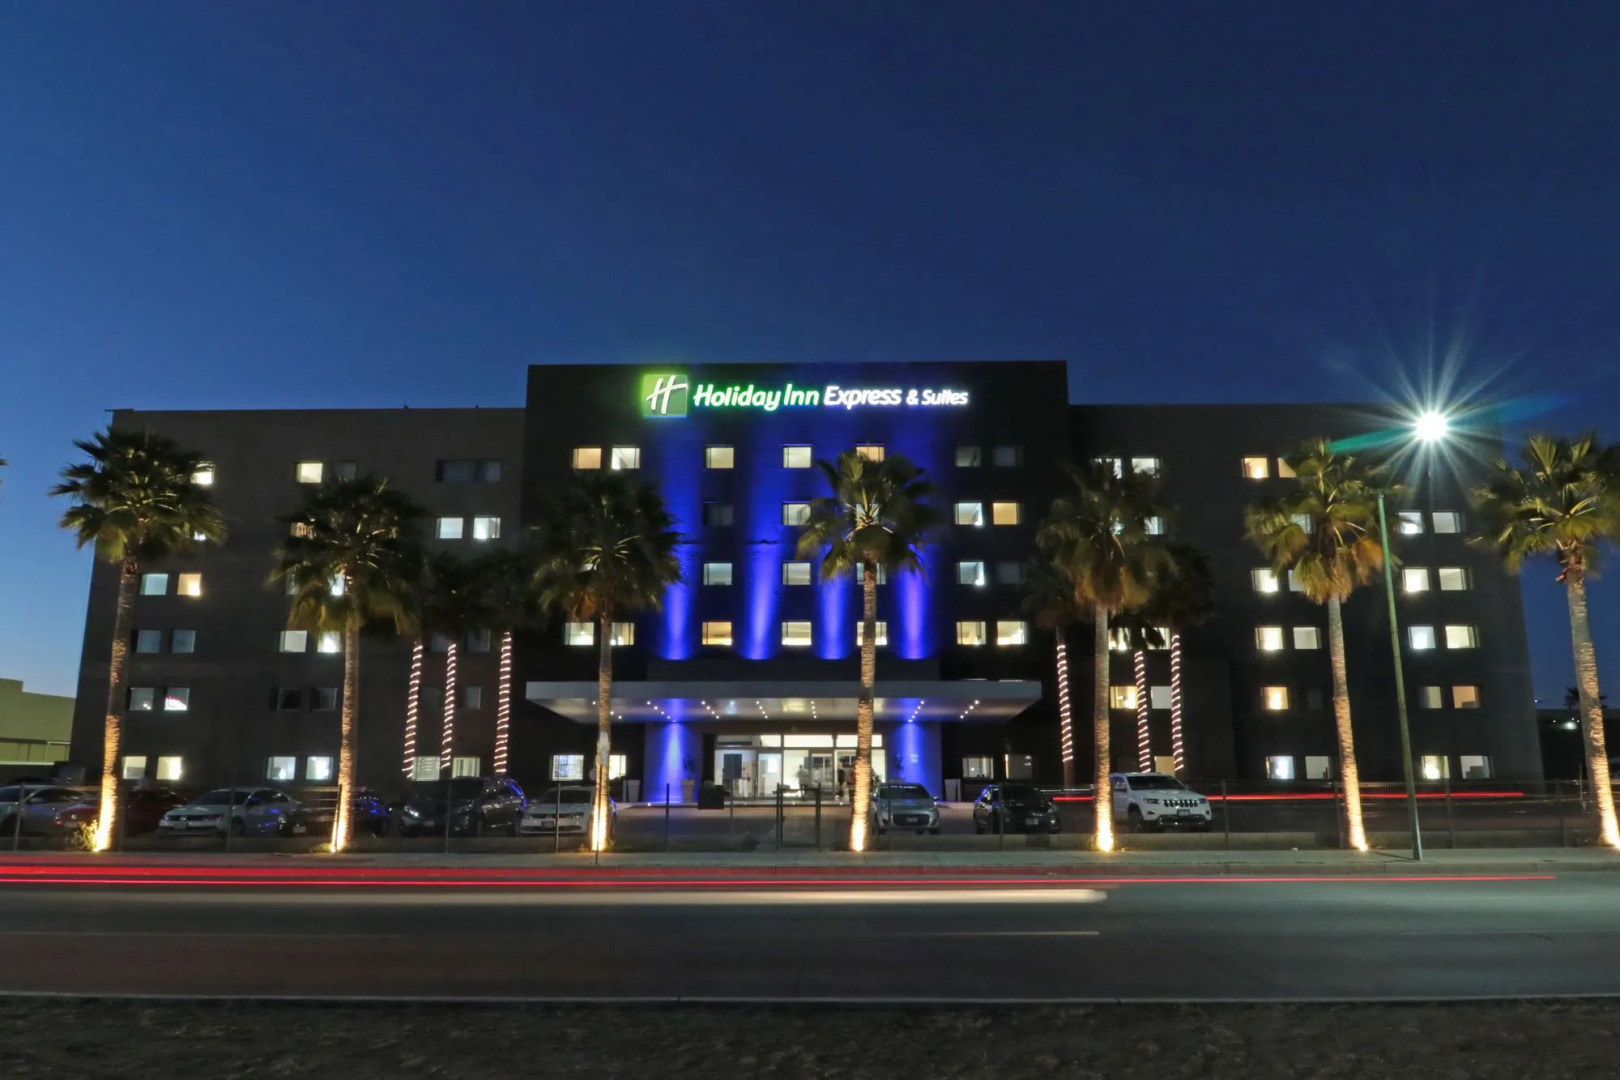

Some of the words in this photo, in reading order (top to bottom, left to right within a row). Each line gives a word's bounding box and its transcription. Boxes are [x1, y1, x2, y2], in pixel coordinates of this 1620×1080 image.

[693, 384, 782, 411] Holiday
[784, 384, 820, 406] Inn
[823, 386, 903, 410] Express
[906, 389, 919, 406] &
[921, 389, 969, 406] Suites
